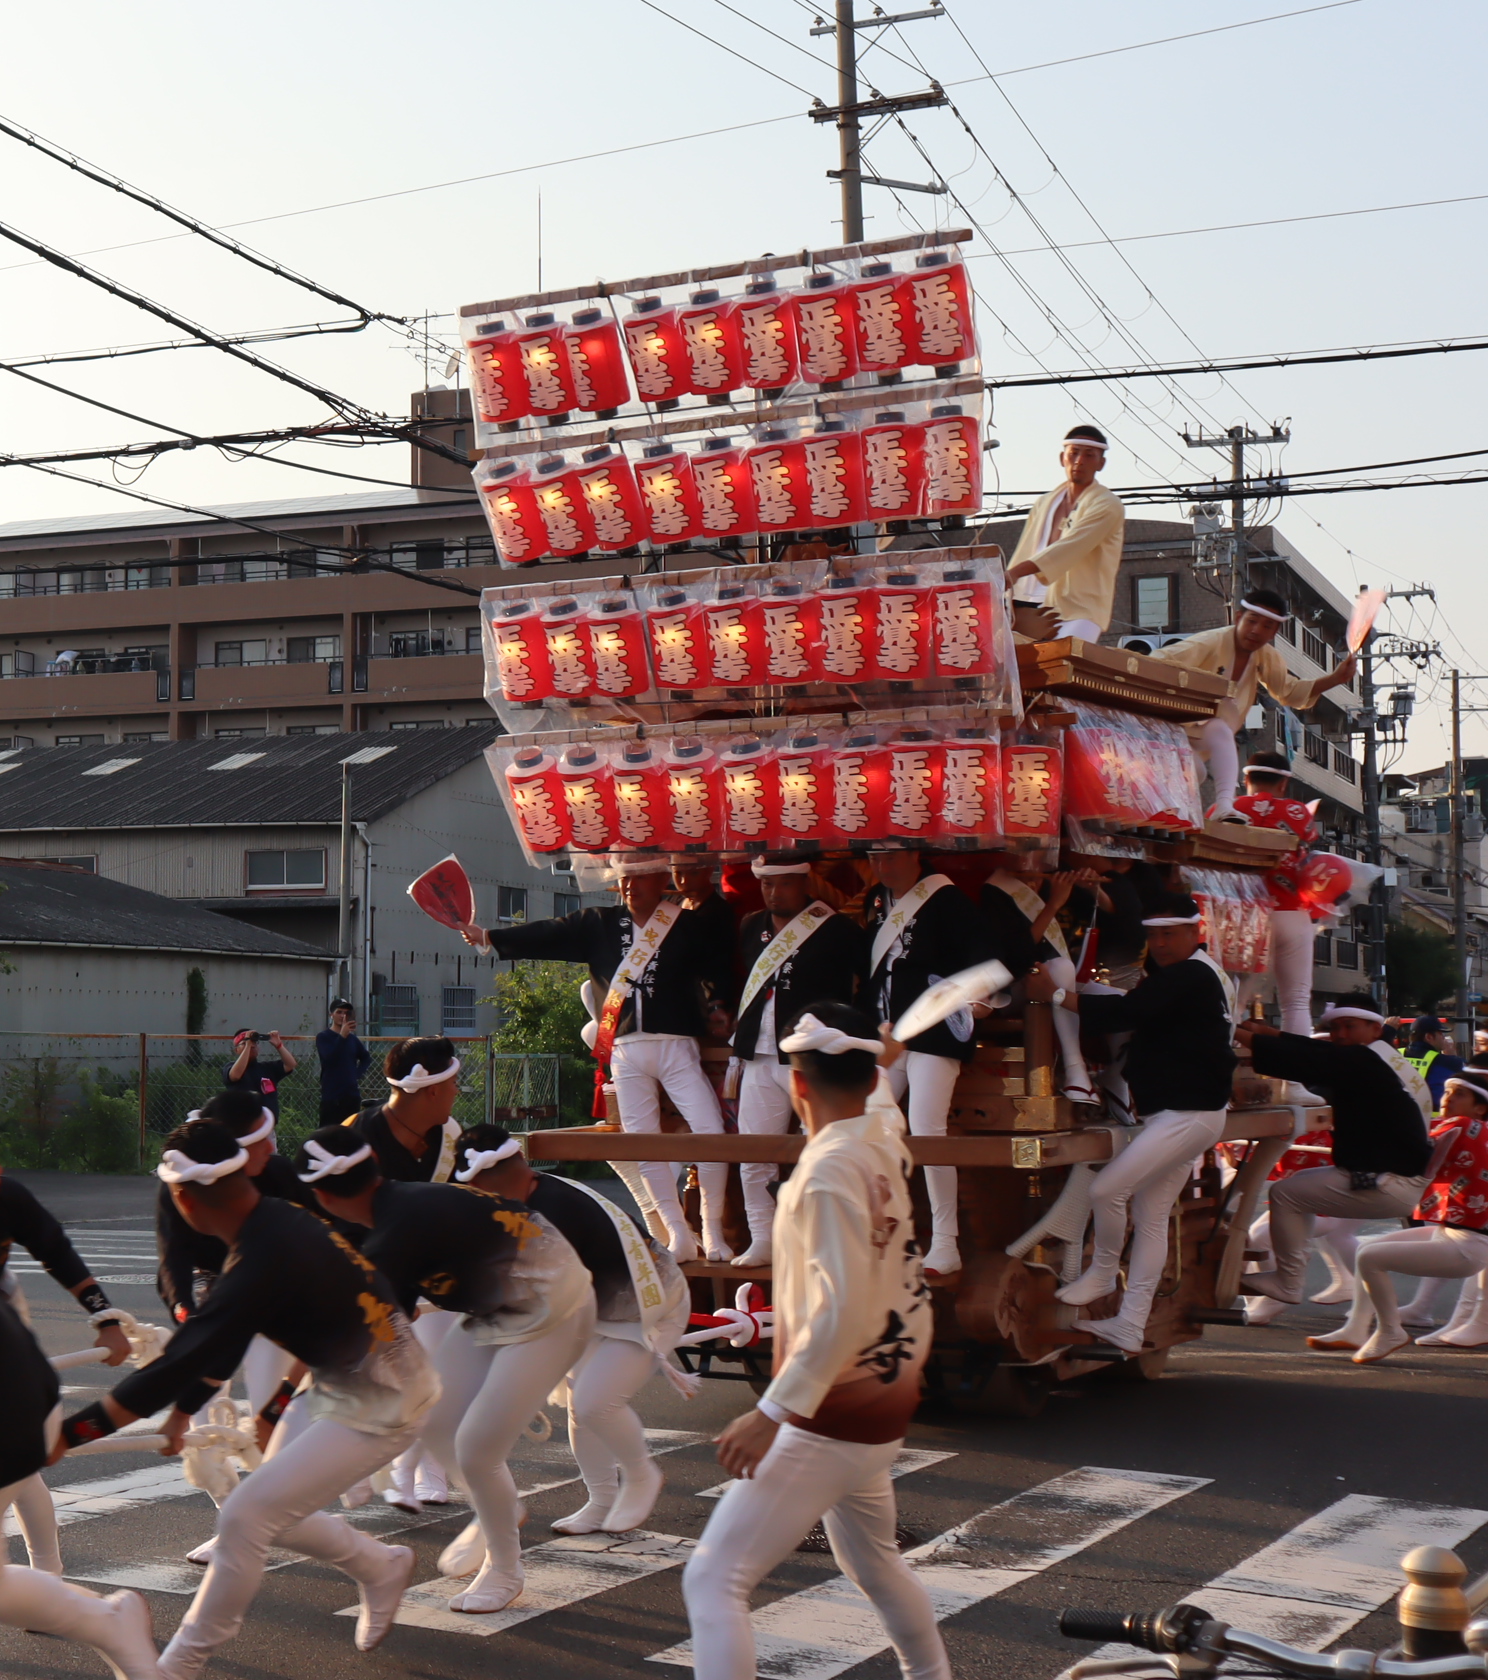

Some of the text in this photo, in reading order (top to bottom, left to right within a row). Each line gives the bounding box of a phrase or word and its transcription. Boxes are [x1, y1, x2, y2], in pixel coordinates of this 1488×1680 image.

[603, 928, 660, 1030] 曳行責任者
